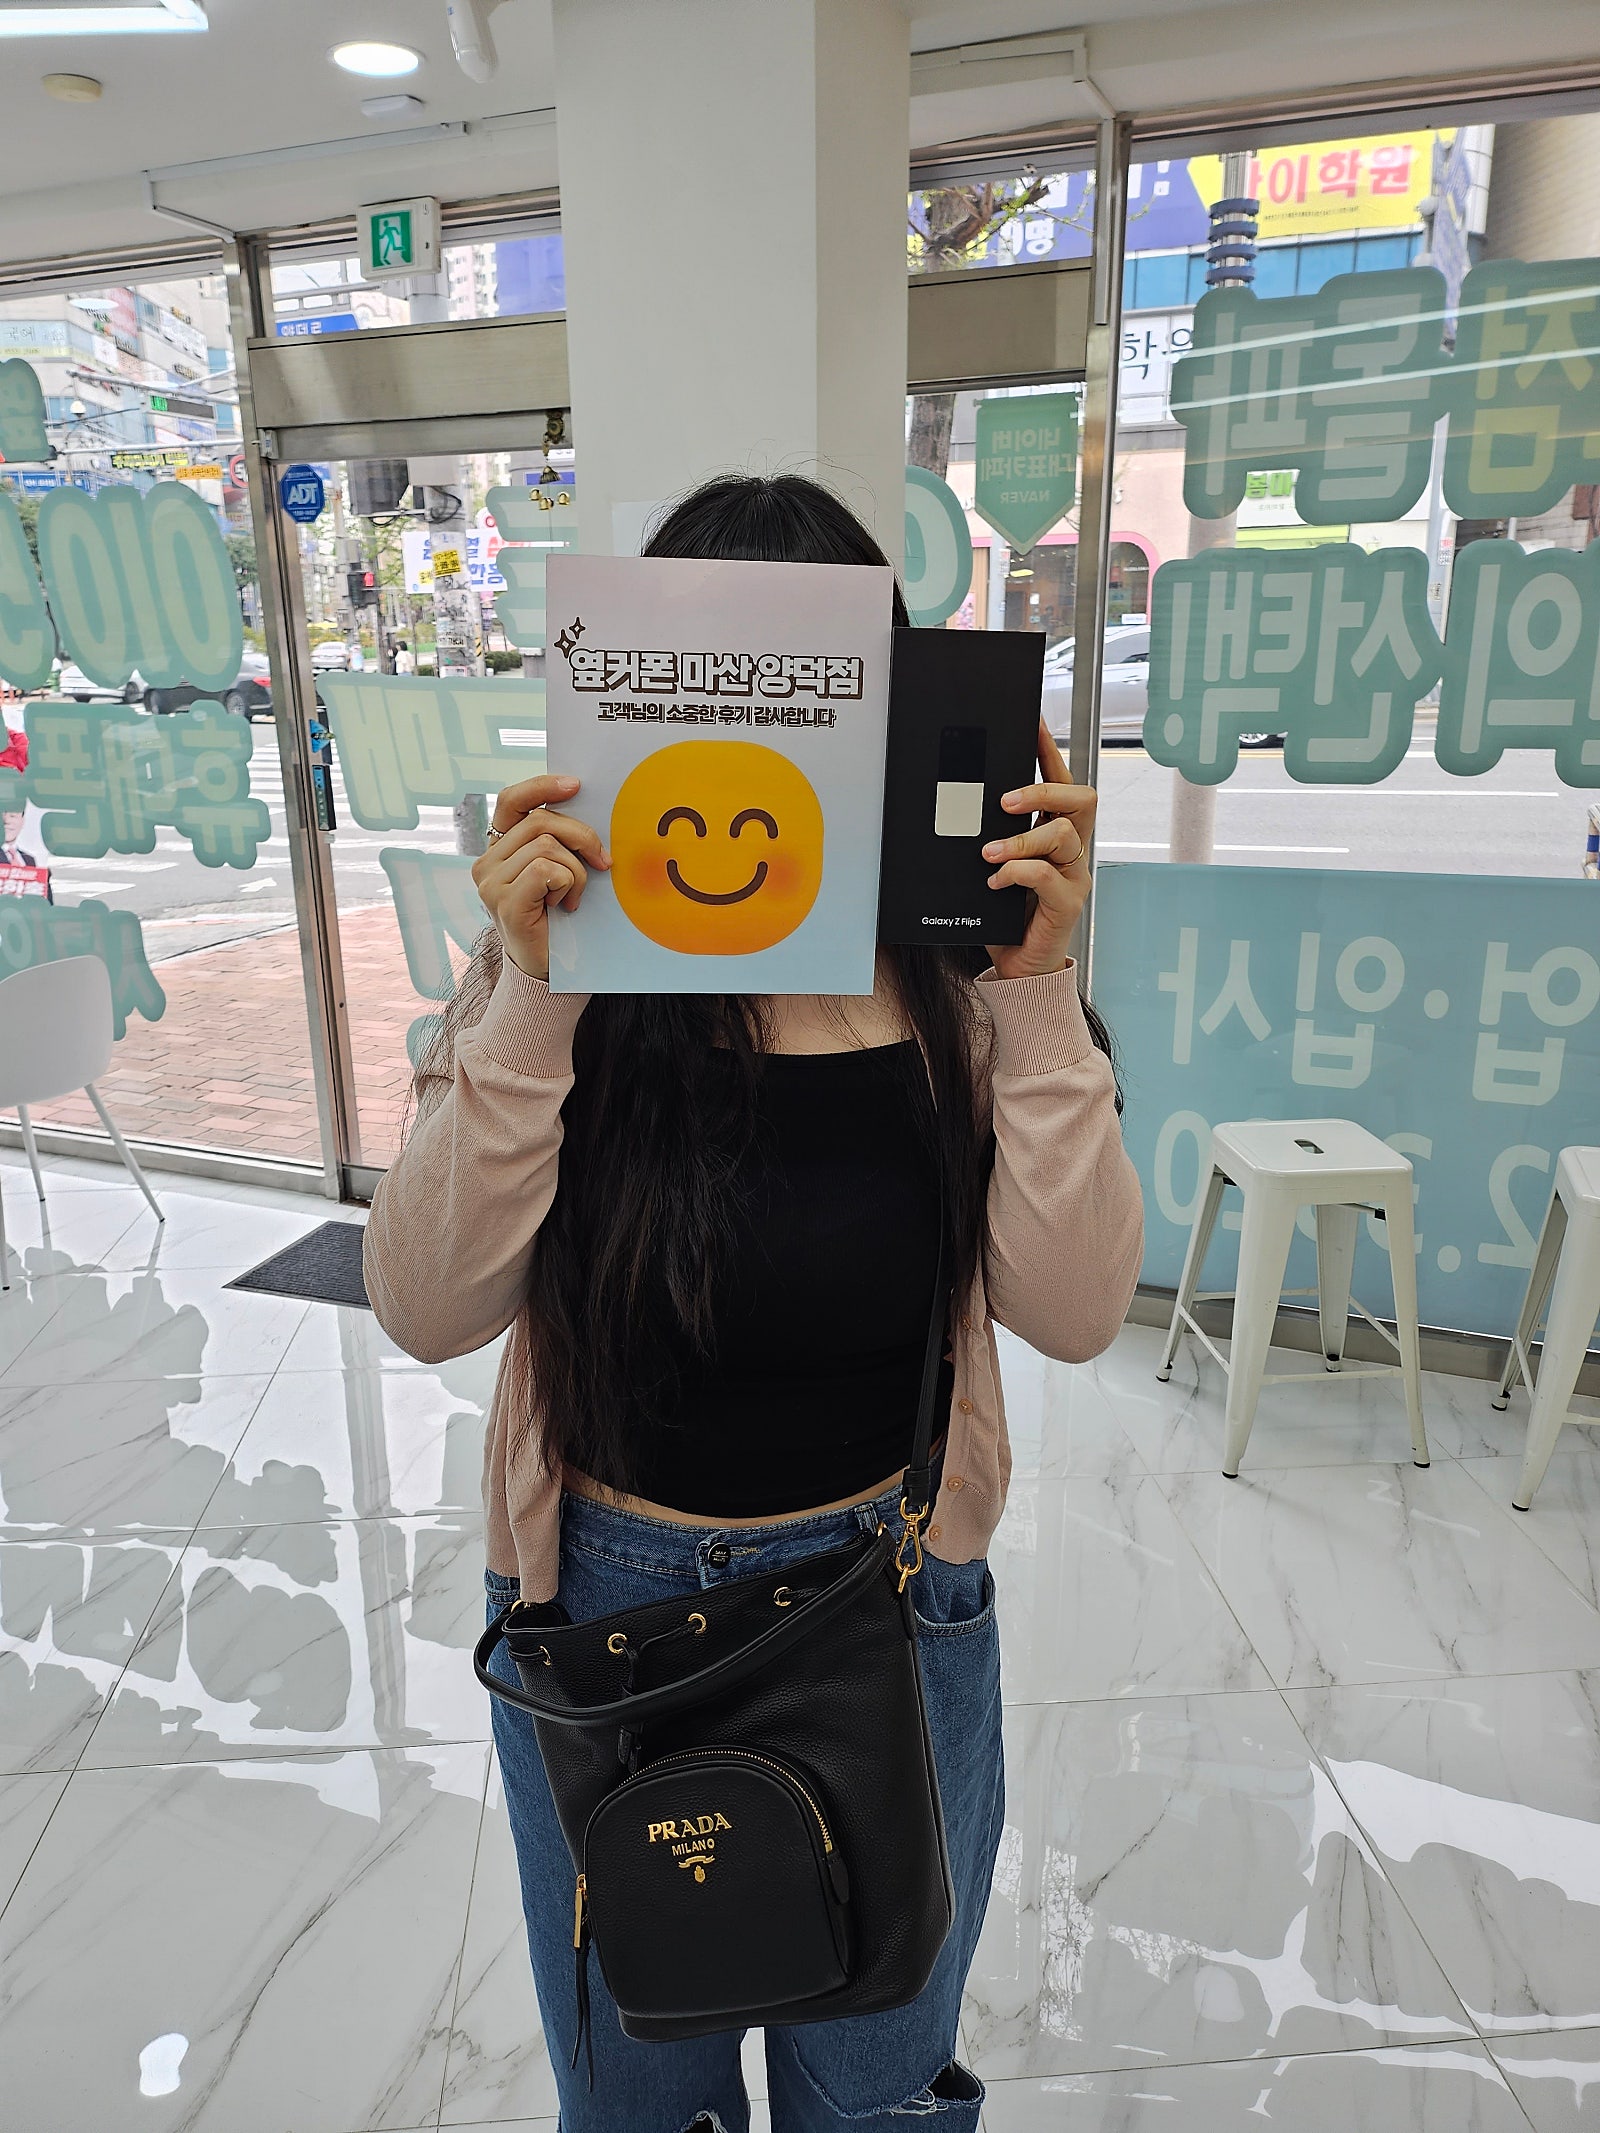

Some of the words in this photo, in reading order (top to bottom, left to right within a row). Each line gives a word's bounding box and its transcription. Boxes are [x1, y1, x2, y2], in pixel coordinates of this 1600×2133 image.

[1248, 144, 1413, 206] 이학원
[287, 483, 318, 505] ADT
[569, 648, 678, 694] 옆커폰
[680, 651, 755, 696] 마산
[756, 654, 864, 699] 양덕점
[598, 702, 664, 722] 고객님의
[666, 703, 717, 723] 소중한
[717, 705, 752, 725] 후기
[753, 706, 837, 727] 감사합니다
[921, 916, 954, 927] Galaxy
[954, 917, 961, 926] Z
[961, 917, 982, 928] Flip5
[647, 1812, 733, 1843] PRADA
[671, 1838, 715, 1856] MILANO
